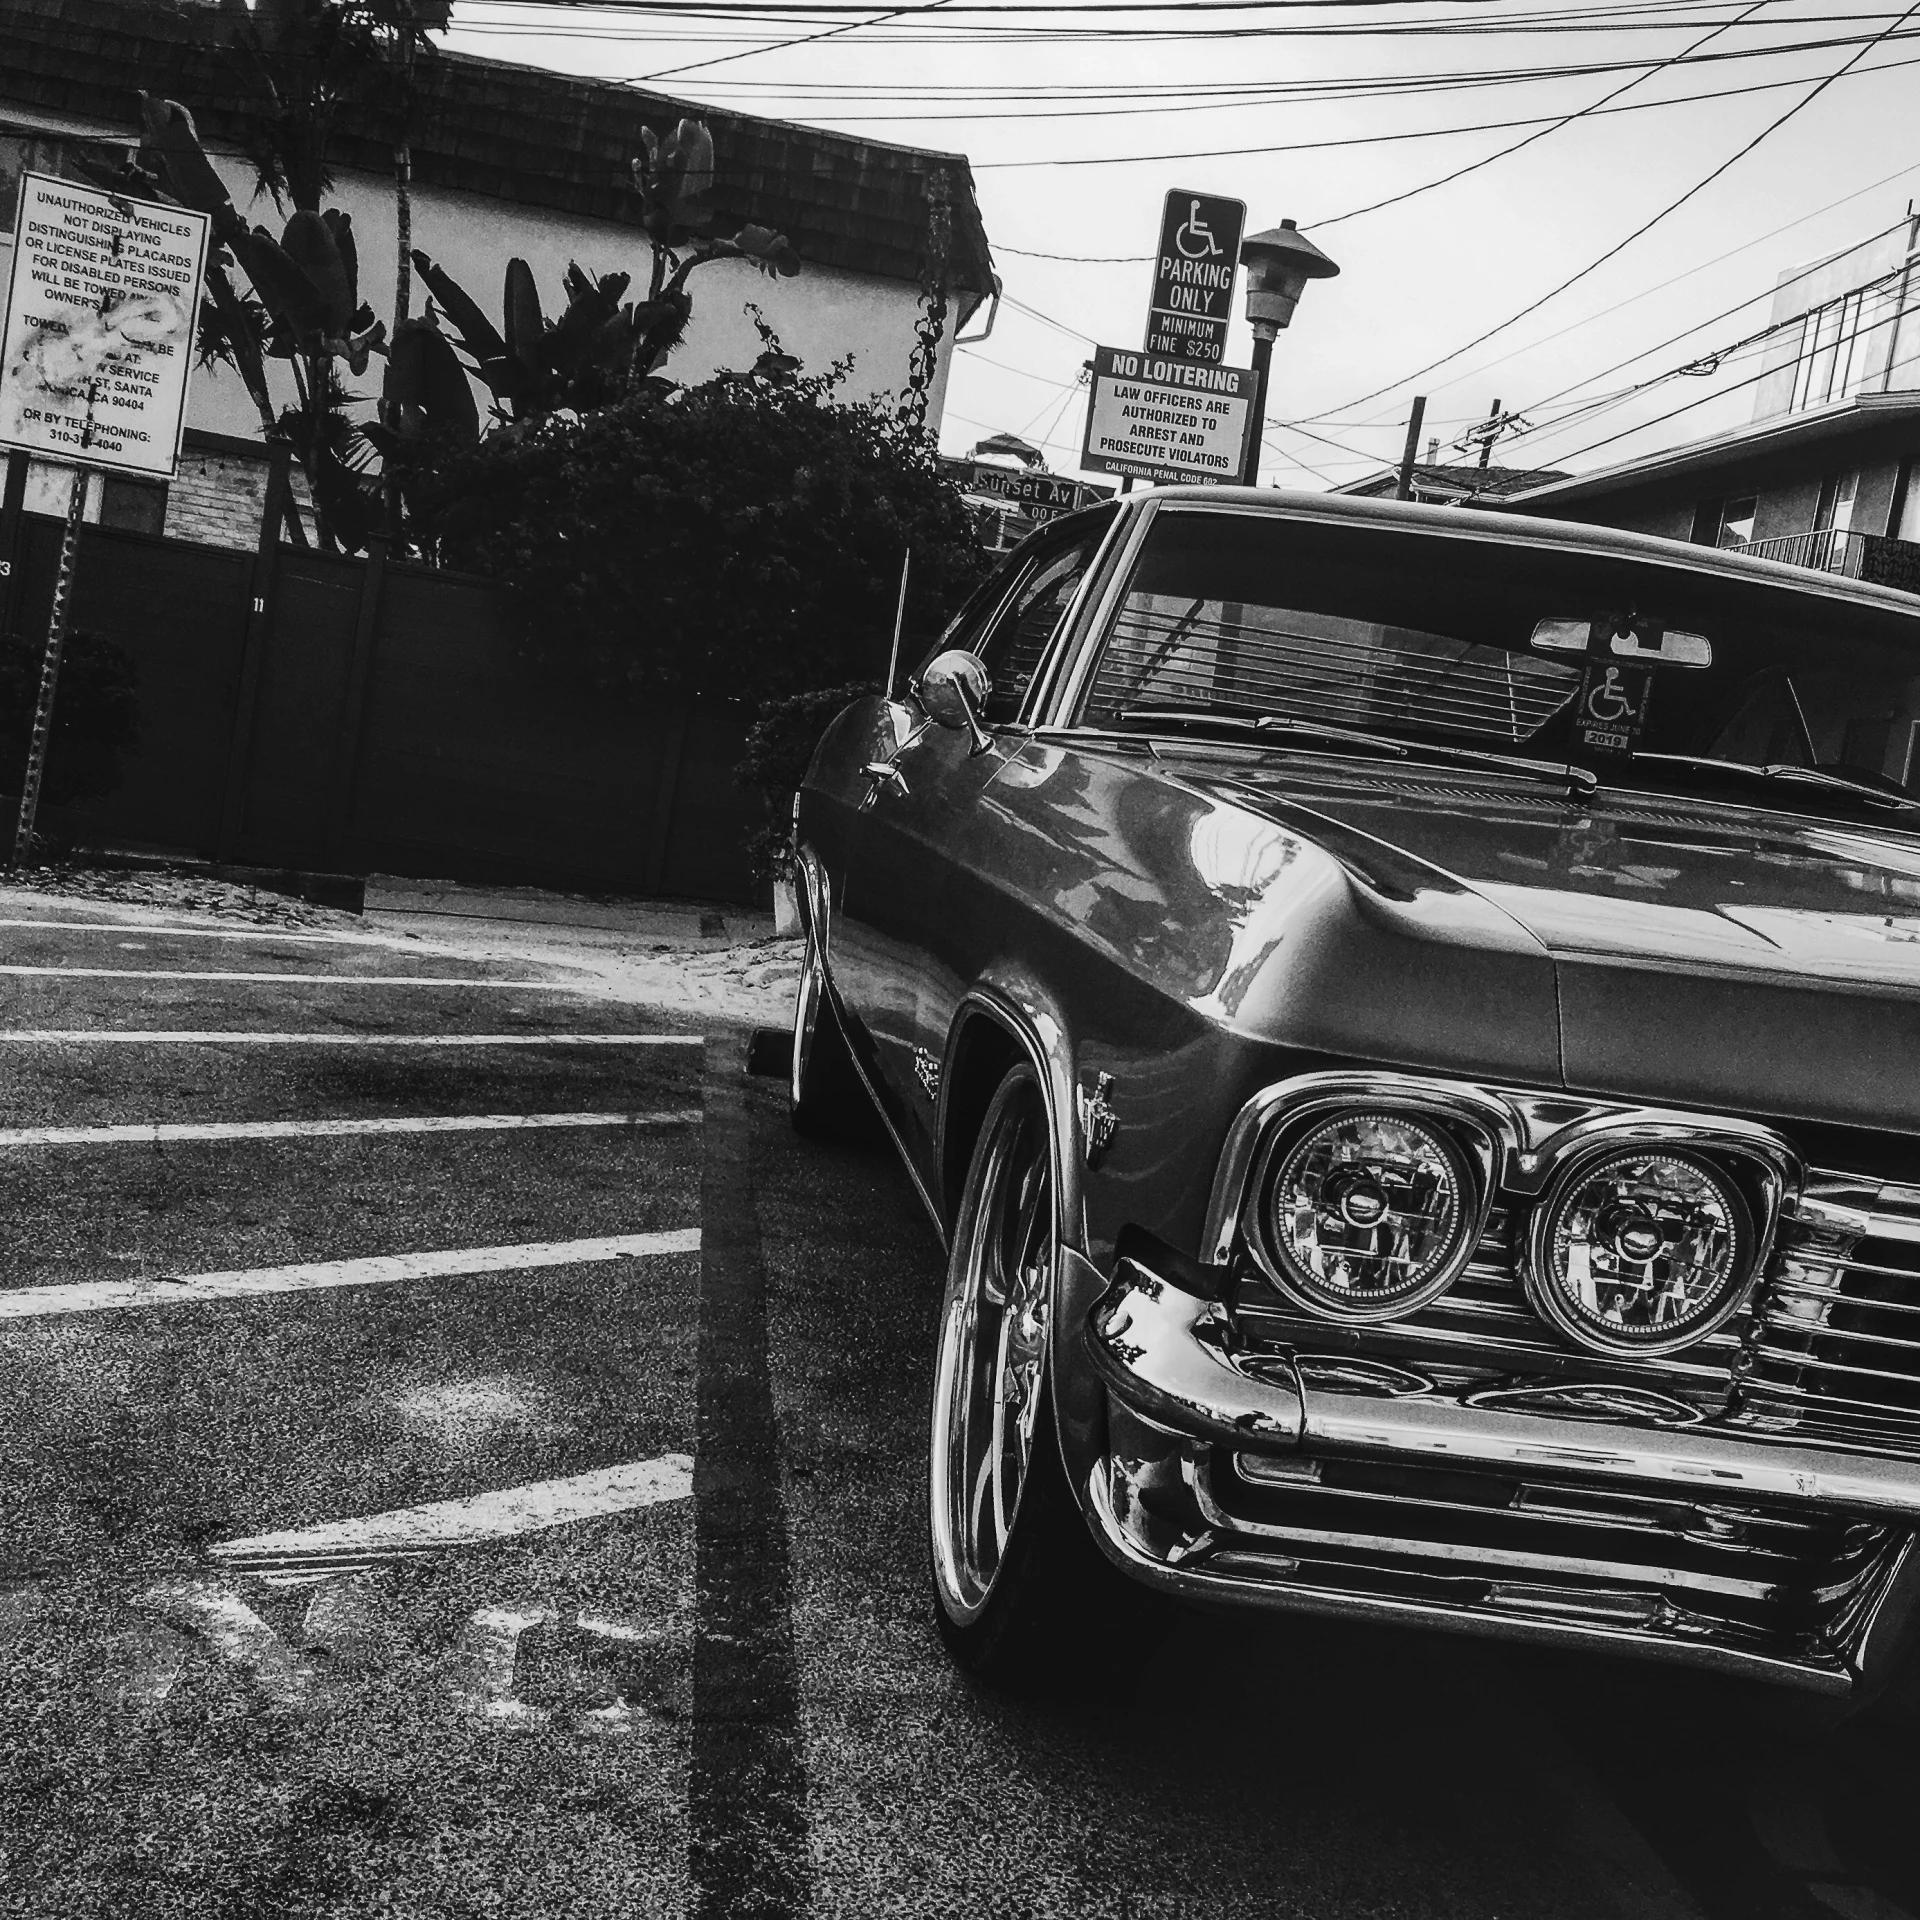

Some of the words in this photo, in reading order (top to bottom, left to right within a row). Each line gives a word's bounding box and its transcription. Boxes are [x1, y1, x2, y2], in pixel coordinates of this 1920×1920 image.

[37, 192, 130, 224] UNAUTHORIZED
[132, 216, 192, 237] VEHICLES
[64, 214, 89, 229] NOT
[91, 221, 162, 246] DISPLAYING
[28, 221, 125, 252] DISTINGUISHING
[127, 245, 192, 268] PLACARDS
[25, 236, 44, 250] OR
[46, 241, 98, 263] LICENSE
[100, 255, 145, 273] PLATES
[148, 265, 191, 283] ISSUED
[32, 253, 58, 269] FOR
[60, 260, 121, 284] DISABLED
[1159, 256, 1232, 290] PARKING
[31, 269, 61, 286] WILL
[63, 276, 80, 290] BE
[83, 281, 127, 300] TOWED
[1170, 285, 1215, 313] ONLY
[1161, 315, 1215, 340] MINIMUM
[157, 344, 175, 356] BE
[1150, 334, 1177, 353] FINE
[1186, 340, 1220, 360] $250
[108, 365, 160, 384] SERVICE
[1111, 353, 1138, 377] NO
[1142, 359, 1240, 393] LOITERING
[95, 376, 111, 391] ST,
[113, 381, 153, 398] SANTA
[1113, 385, 1141, 400] LAW
[1143, 389, 1203, 411] OFFICERS
[1205, 400, 1231, 415] ARE
[112, 396, 145, 411] 90404
[23, 408, 42, 421] OR
[44, 412, 61, 425] BY
[64, 416, 151, 443] TELEPHONING:
[1121, 404, 1198, 428] AUTHORIZED
[1201, 417, 1218, 431] TO
[49, 429, 122, 452] 310-3-4040
[1129, 424, 1177, 442] ARREST
[1179, 432, 1205, 447] AND
[1099, 437, 1166, 459] PROSECUTE
[1168, 447, 1230, 469] VIOLATORS
[980, 474, 1040, 499] Sunset
[1105, 461, 1152, 477] CALIFORNIA
[1153, 468, 1179, 481] PENAL
[1180, 472, 1202, 485] CODE
[1576, 718, 1609, 732] EXPIRES
[1610, 721, 1631, 734] JUNE
[1589, 732, 1622, 747] 2019
